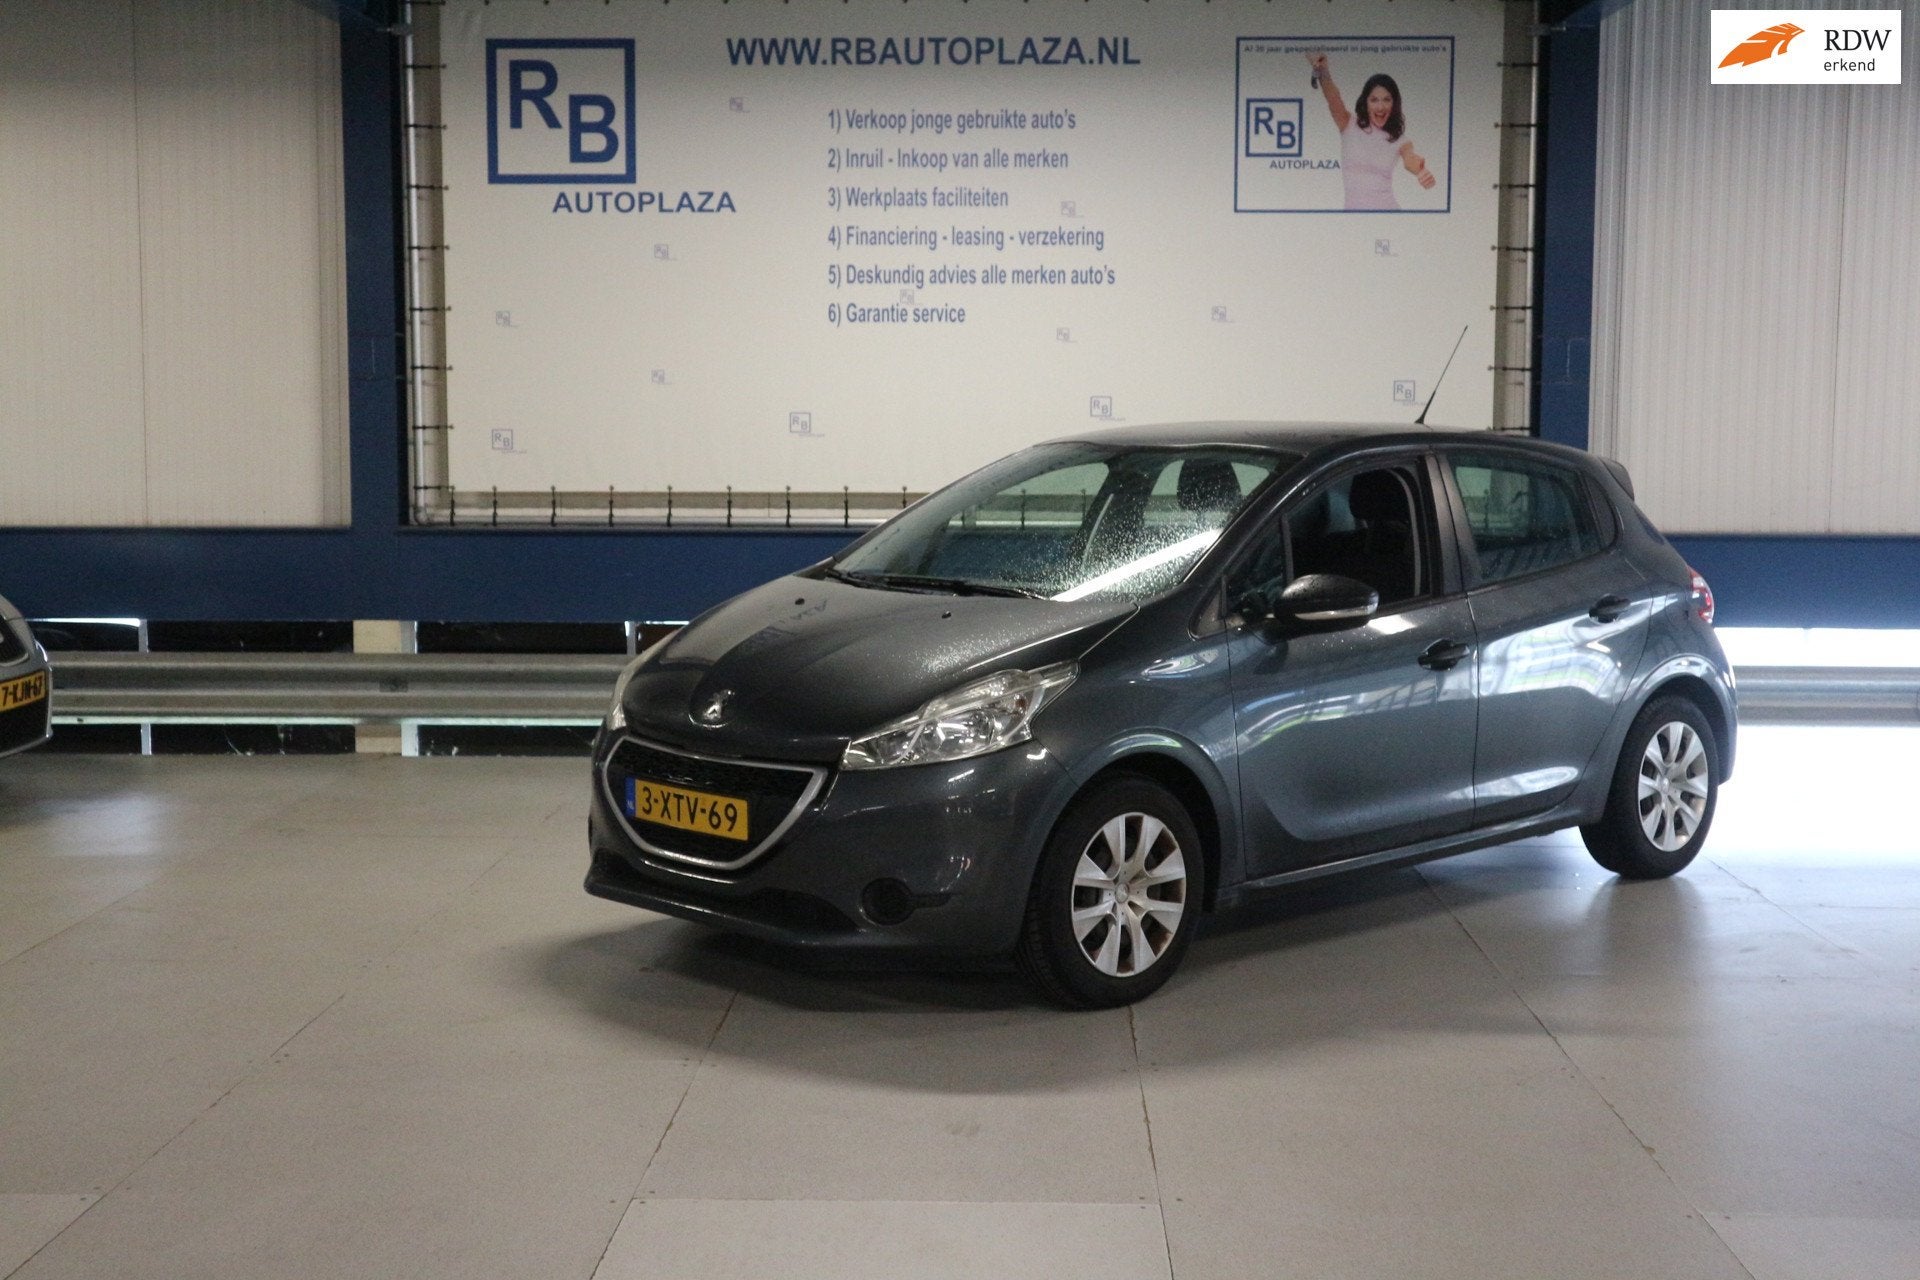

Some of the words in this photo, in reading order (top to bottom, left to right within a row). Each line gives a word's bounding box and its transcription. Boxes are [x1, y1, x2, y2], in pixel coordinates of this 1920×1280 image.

[726, 37, 1141, 66] WWW.RBAUTOPLAZA.NL
[827, 110, 841, 134] 1)
[846, 110, 906, 134] Verkoop
[910, 110, 952, 135] jonge
[956, 110, 1027, 135] gebruikte
[1031, 109, 1076, 130] auto's
[827, 149, 841, 173] 2)
[846, 148, 883, 169] Inruil
[897, 148, 948, 173] Inkoop
[952, 153, 979, 169] van
[984, 148, 1010, 169] alle
[1014, 149, 1069, 169] merken
[1269, 159, 1341, 171] AUTOPLAZA
[552, 192, 736, 214] AUTOPLAZA
[828, 188, 841, 211] 3)
[846, 187, 928, 211] Werkplaats
[932, 187, 1009, 208] faciliteiten
[828, 226, 841, 250] 4)
[846, 226, 938, 251] Financiering
[951, 226, 1005, 252] leasing
[1018, 226, 1105, 252] verzekering
[828, 265, 841, 289] 5)
[846, 265, 924, 289] Deskundig
[928, 265, 977, 286] advies
[981, 265, 1007, 286] alle
[1011, 265, 1066, 286] merken
[1070, 265, 1116, 286] auto's
[828, 304, 841, 327] 6)
[846, 303, 909, 324] Garantie
[912, 304, 966, 324] service
[642, 786, 738, 832] 3-XTV-69
